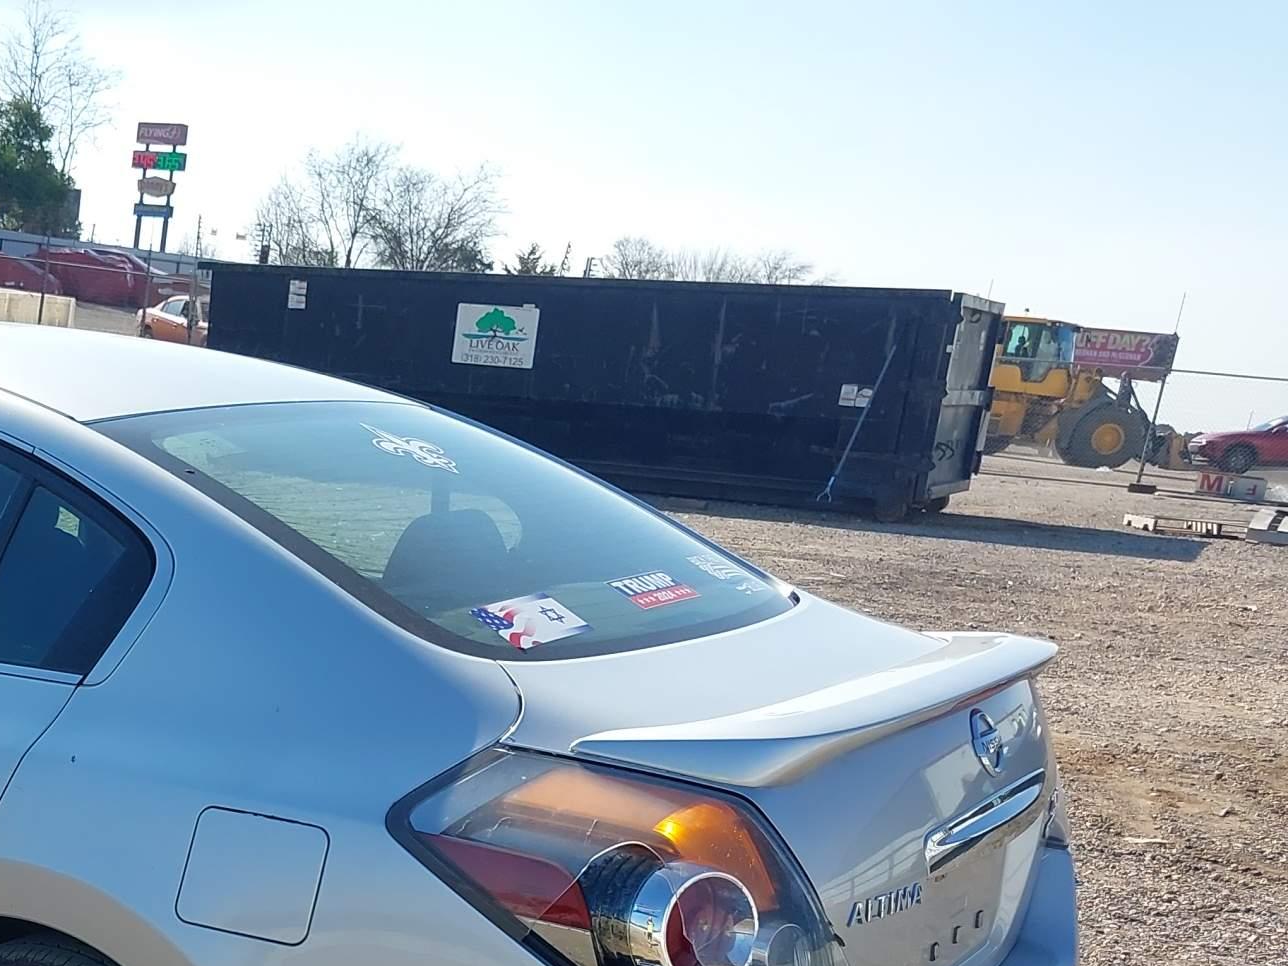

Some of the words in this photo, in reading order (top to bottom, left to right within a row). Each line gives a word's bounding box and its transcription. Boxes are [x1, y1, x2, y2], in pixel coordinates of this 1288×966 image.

[469, 339, 494, 350] LIVE
[495, 340, 521, 352] OAK
[610, 572, 677, 597] TRUMP
[846, 881, 923, 928] ALTIMA
